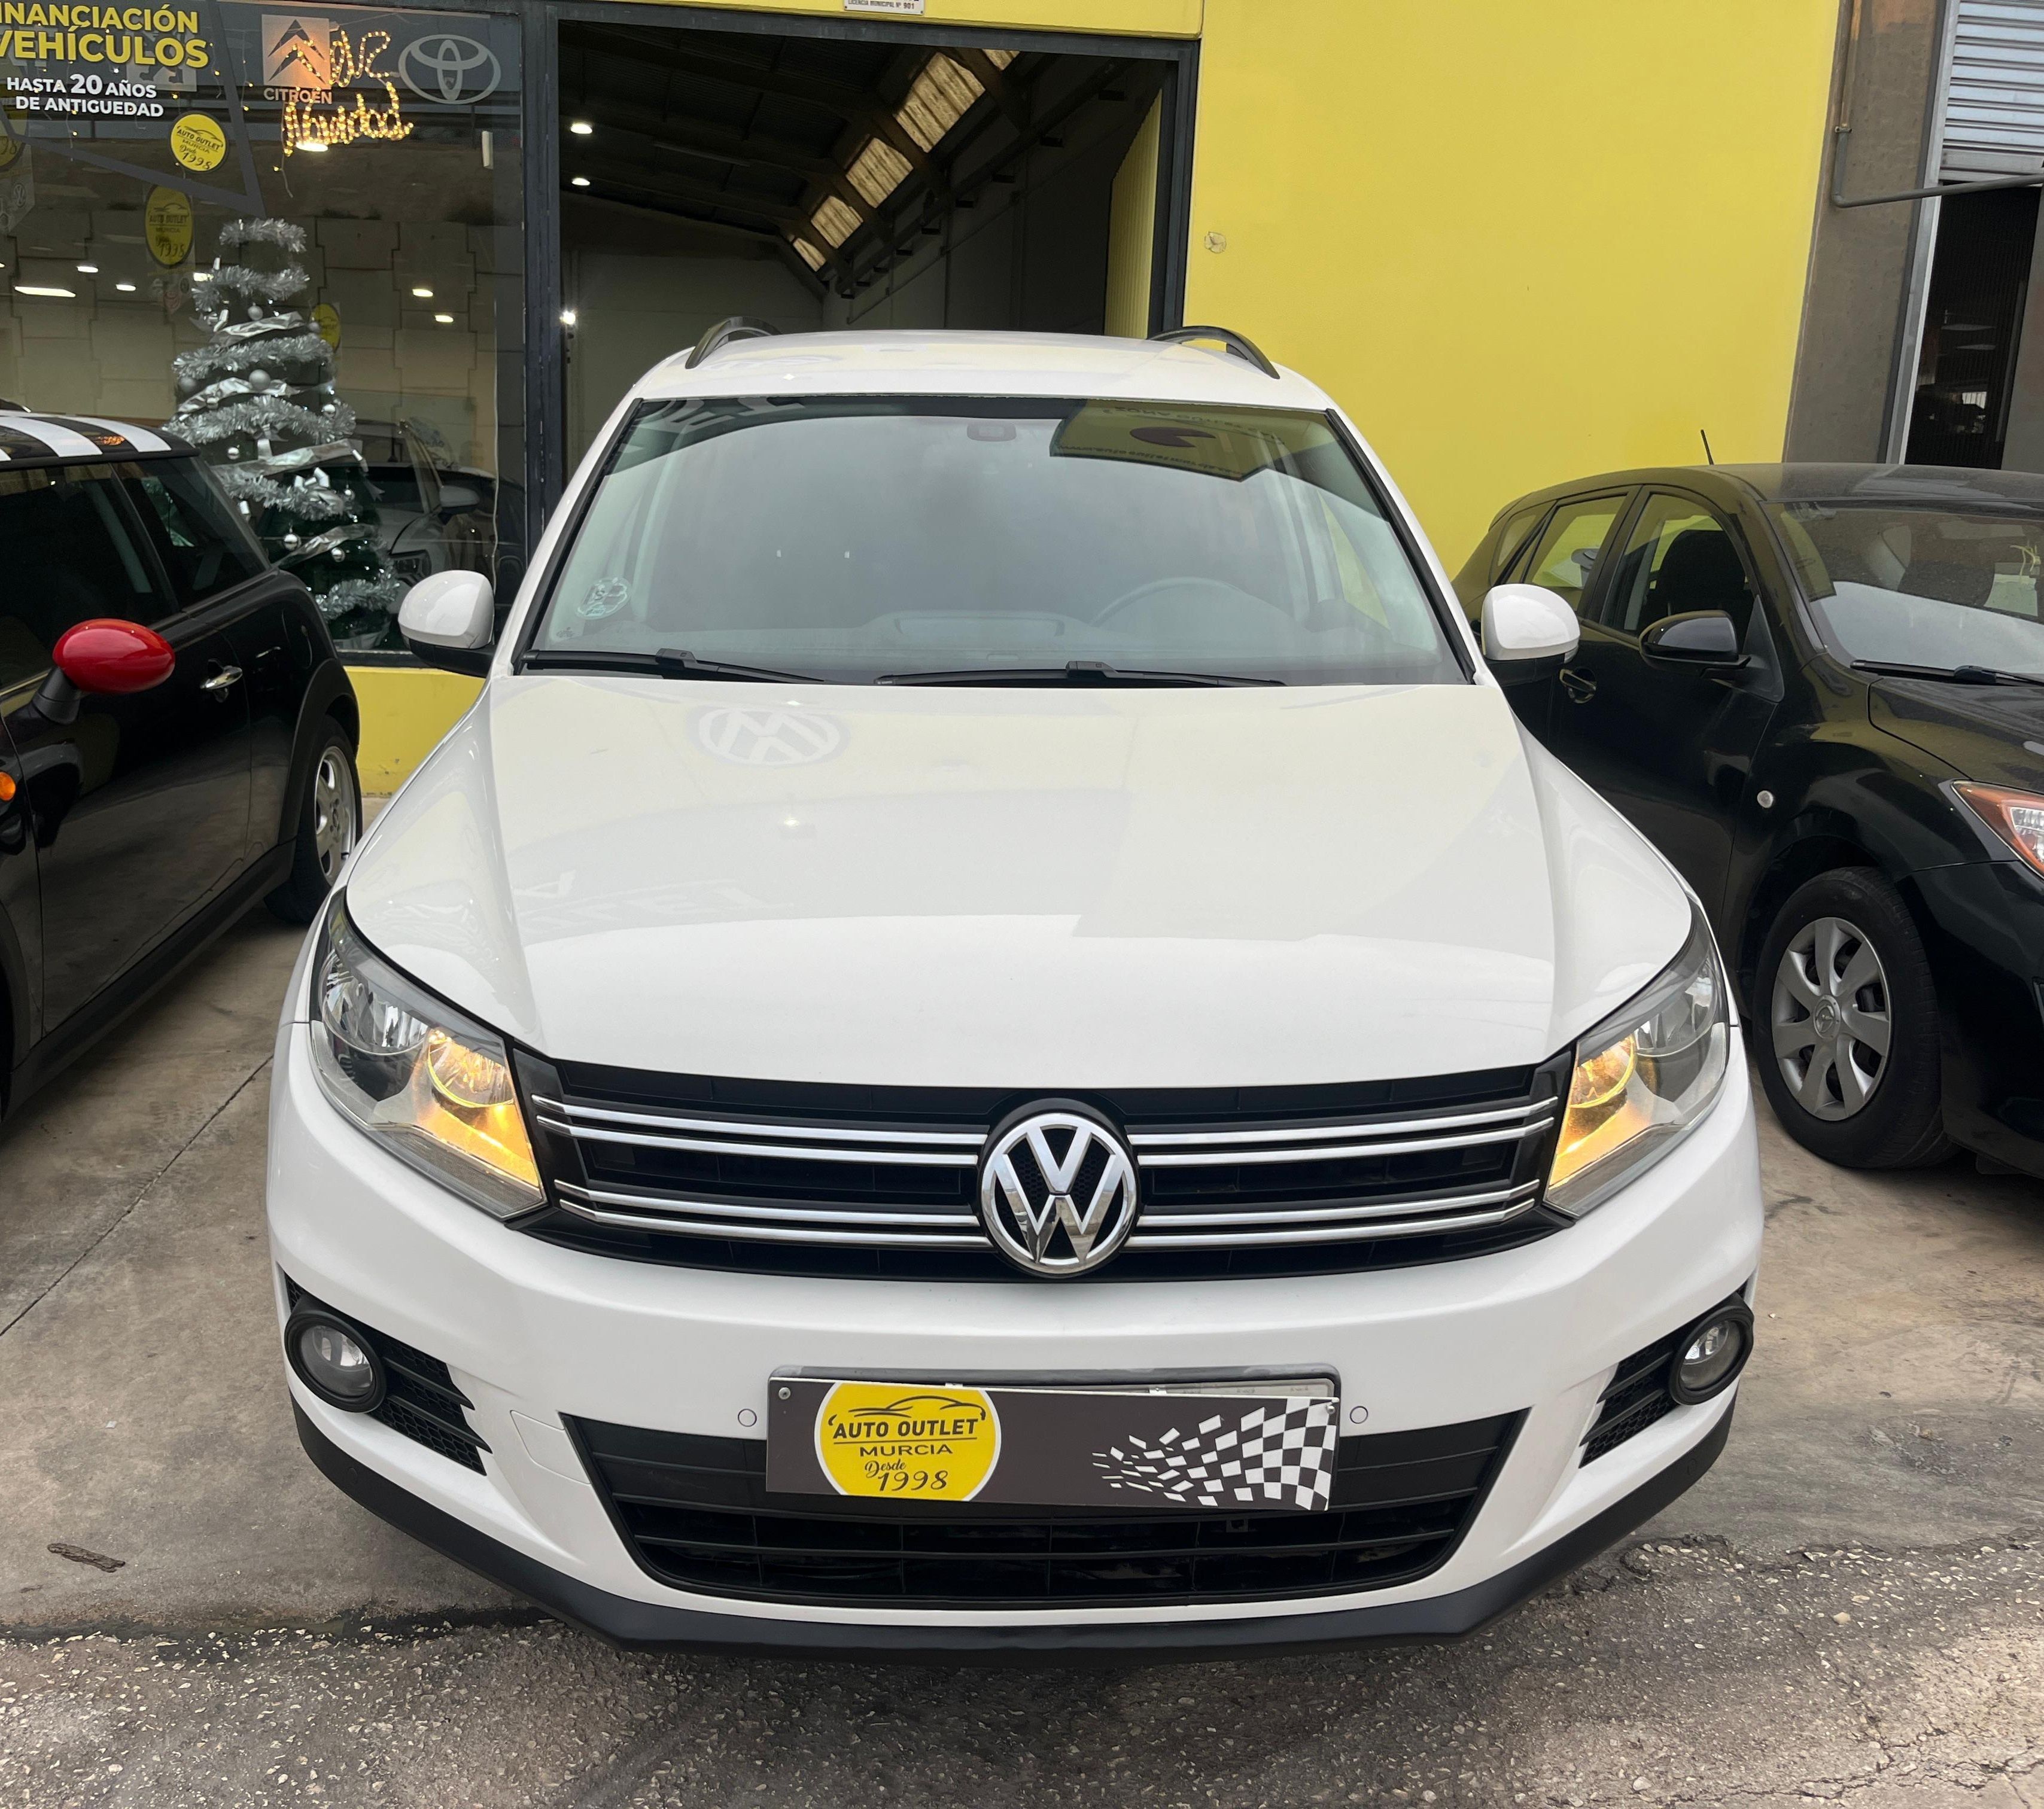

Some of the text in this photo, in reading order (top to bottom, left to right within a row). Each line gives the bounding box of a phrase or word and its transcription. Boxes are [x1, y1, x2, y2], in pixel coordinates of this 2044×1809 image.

[0, 2, 198, 34] NANCIACIÓN
[7, 73, 157, 98] HASTA 20 AÑOS
[16, 96, 40, 110] DE
[44, 98, 164, 117] ANTIGUEDAD
[182, 153, 212, 170] 1998
[860, 1443, 953, 1457] MURCIA
[865, 1458, 906, 1478] Desde
[879, 1470, 948, 1492] 1998
